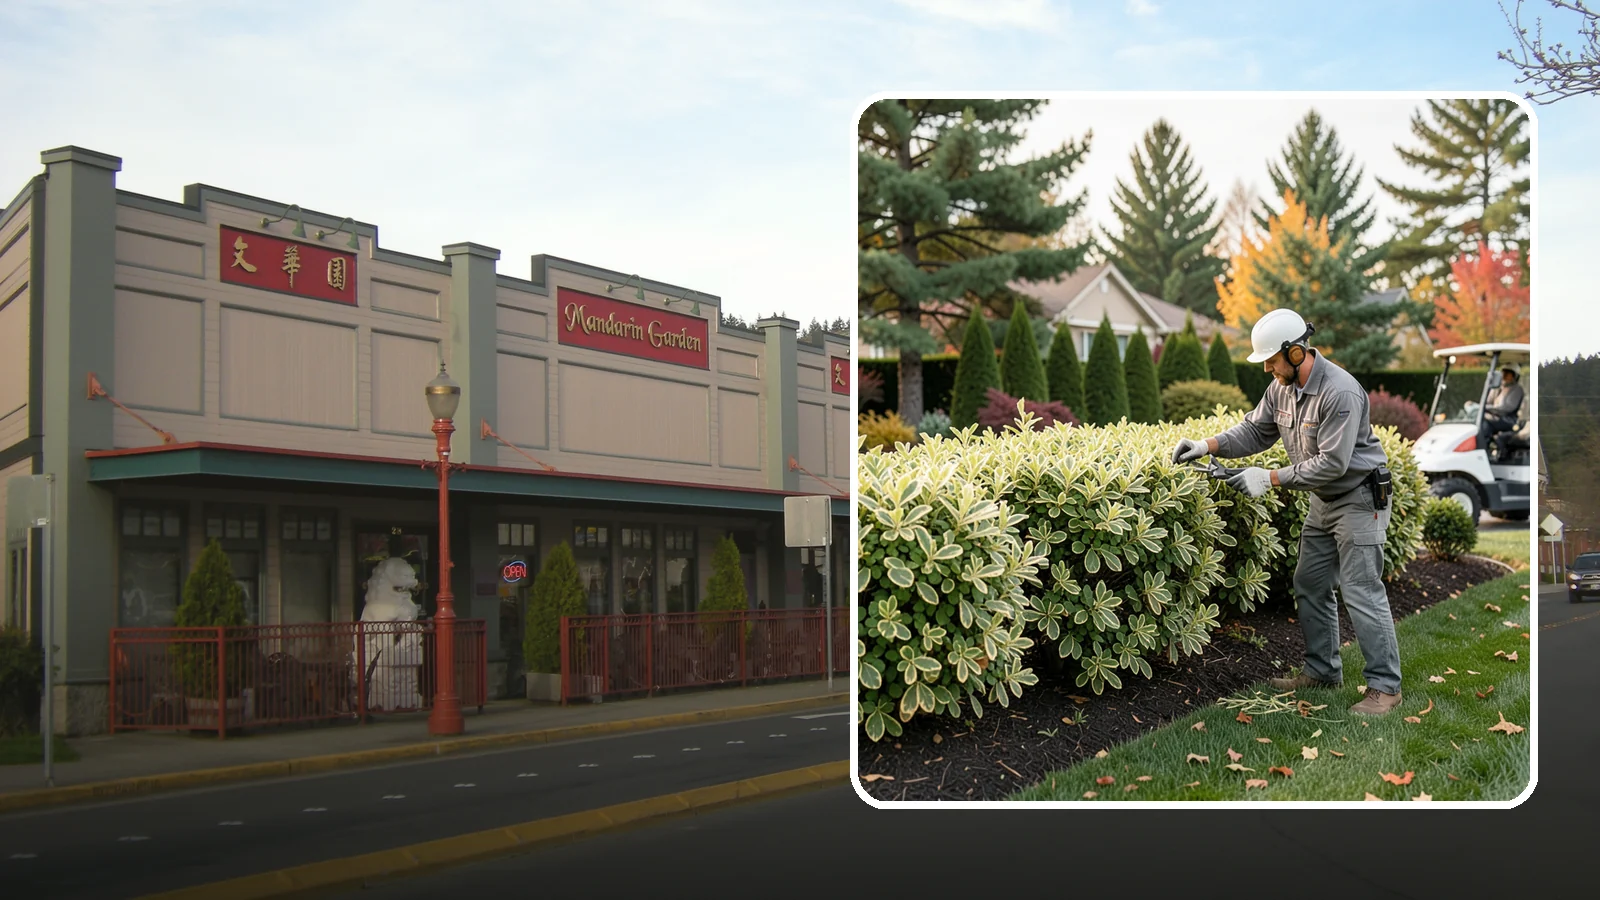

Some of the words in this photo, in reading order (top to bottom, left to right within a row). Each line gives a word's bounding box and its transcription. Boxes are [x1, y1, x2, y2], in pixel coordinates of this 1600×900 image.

[564, 302, 644, 341] Mandarin
[647, 320, 702, 352] Garden
[503, 565, 527, 578] OPEN
